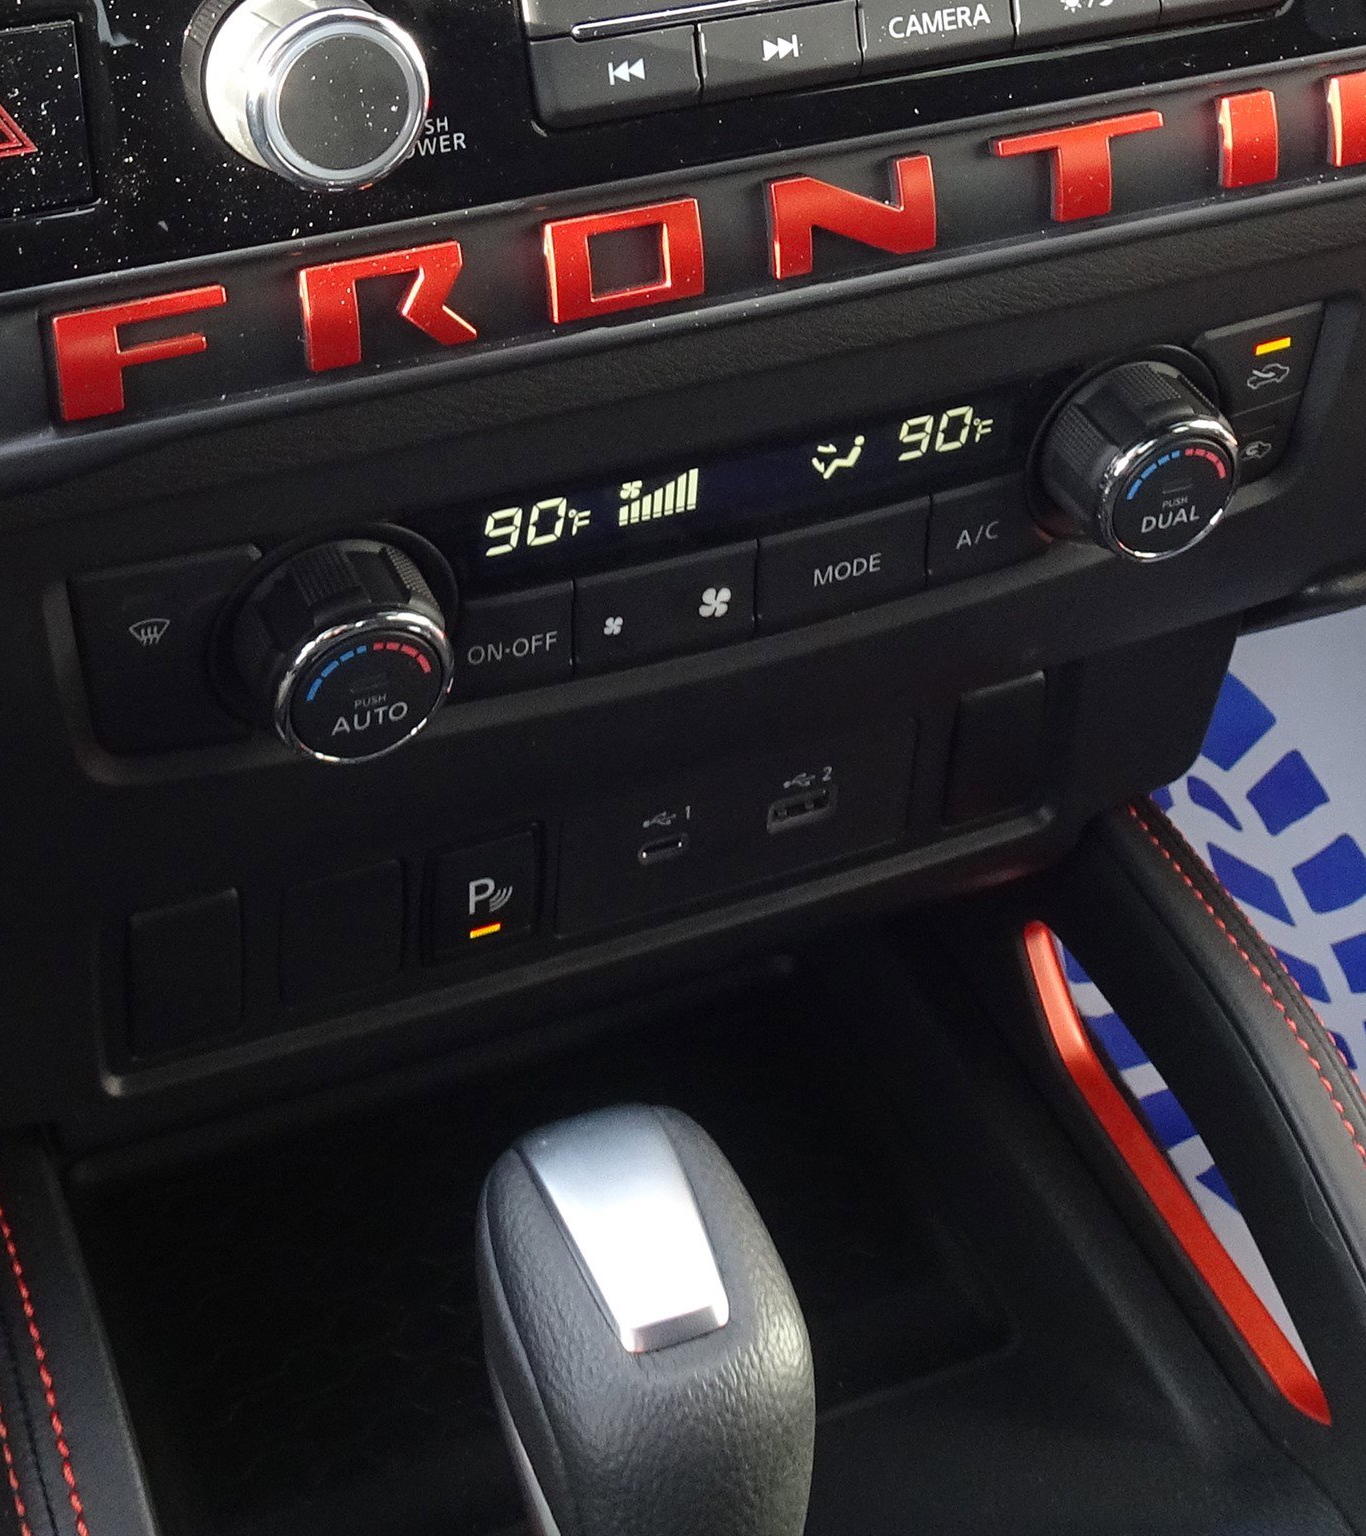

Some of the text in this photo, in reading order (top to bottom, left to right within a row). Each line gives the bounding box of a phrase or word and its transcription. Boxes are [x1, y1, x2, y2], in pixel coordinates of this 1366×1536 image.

[887, 2, 992, 41] CAMERA
[423, 115, 449, 135] SH
[405, 132, 467, 160] WER
[1161, 495, 1189, 509] PUSH
[1140, 504, 1201, 534] DUAL
[954, 519, 1000, 551] A/C
[811, 552, 883, 586] MODE
[354, 693, 387, 709] PUSH
[330, 700, 408, 737] AUTO
[821, 766, 833, 782] 2
[467, 877, 494, 915] P
